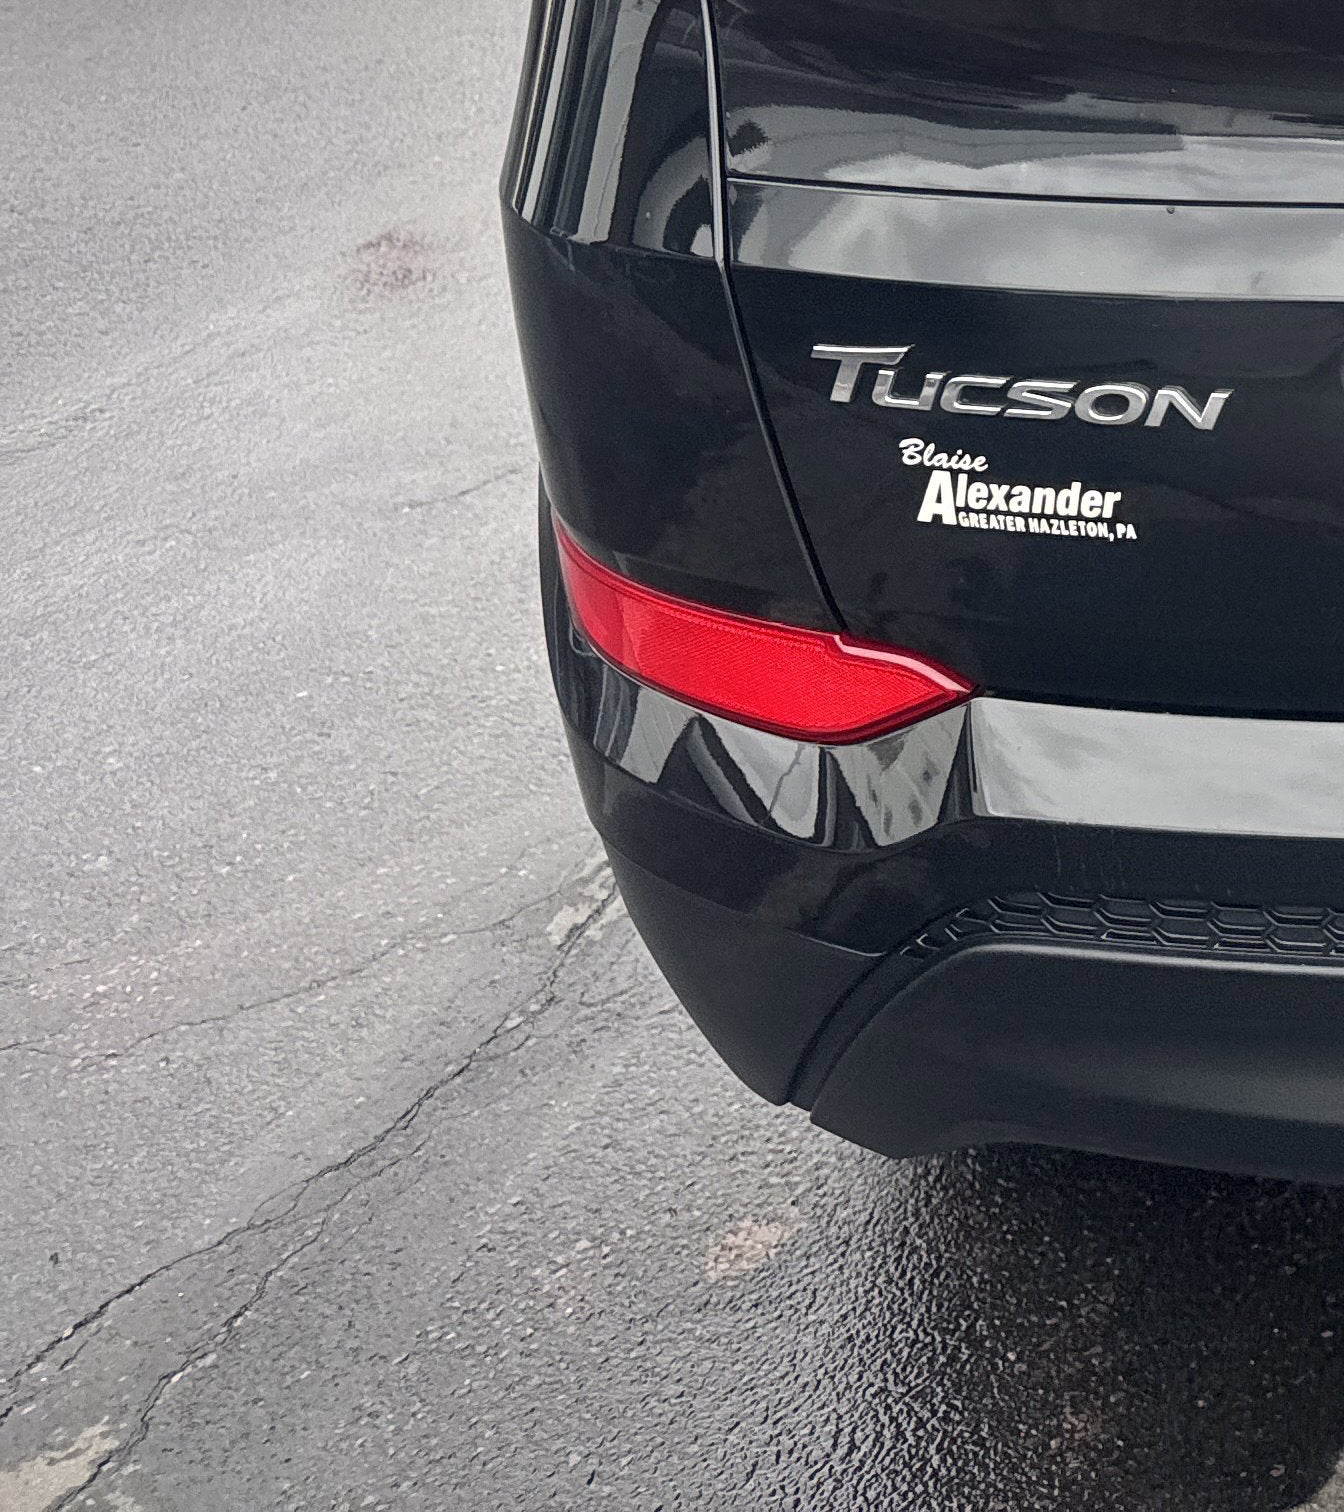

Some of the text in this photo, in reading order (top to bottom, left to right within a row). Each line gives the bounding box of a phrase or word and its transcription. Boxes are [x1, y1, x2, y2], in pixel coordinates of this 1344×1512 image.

[899, 437, 989, 473] Blaise
[916, 469, 1122, 525] Alexander
[957, 511, 1138, 542] GREATER HAZLETON, PA
